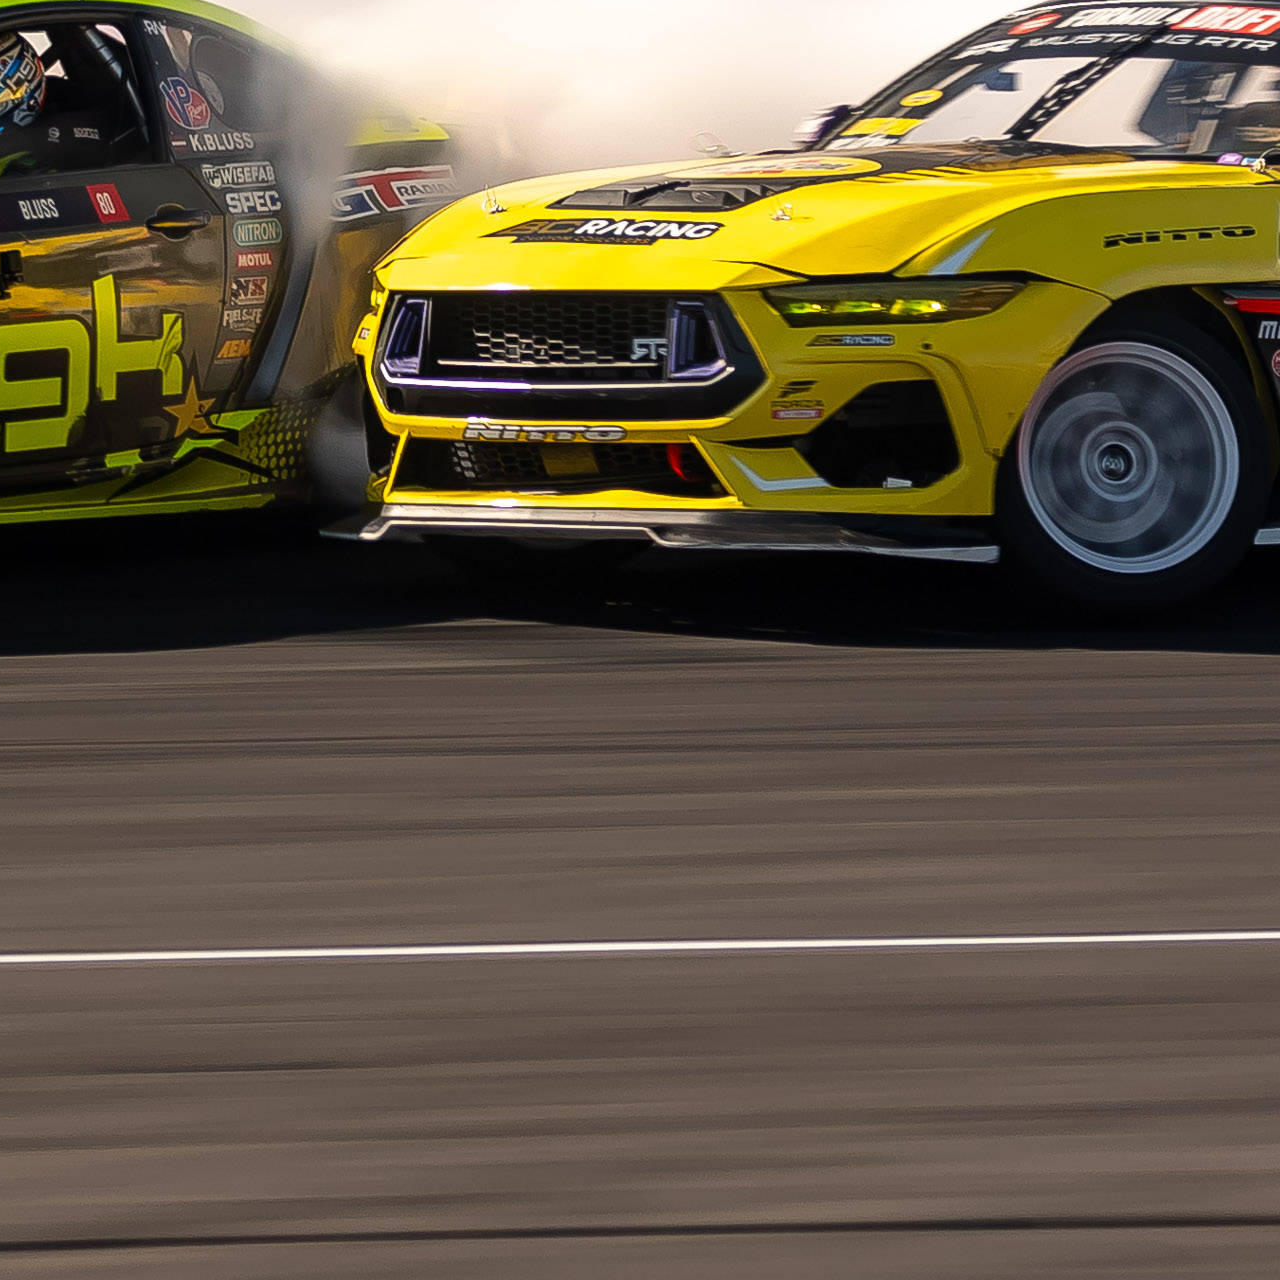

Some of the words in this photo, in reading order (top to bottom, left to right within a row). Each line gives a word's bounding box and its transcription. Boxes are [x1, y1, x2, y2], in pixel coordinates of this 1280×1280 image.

[1054, 6, 1200, 29] FORMULA
[1195, 35, 1278, 52] RTR
[189, 132, 254, 151] K.BLUSS
[220, 166, 275, 184] WISEFAB
[19, 198, 58, 220] BLUSS
[94, 192, 116, 215] 80
[226, 190, 281, 214] SPEC
[237, 222, 276, 240] NITRON
[574, 219, 721, 239] RACING
[1103, 224, 1256, 248] NITTO
[238, 253, 272, 267] MOTUL
[216, 339, 251, 358] AEM
[463, 417, 627, 441] NITTO
